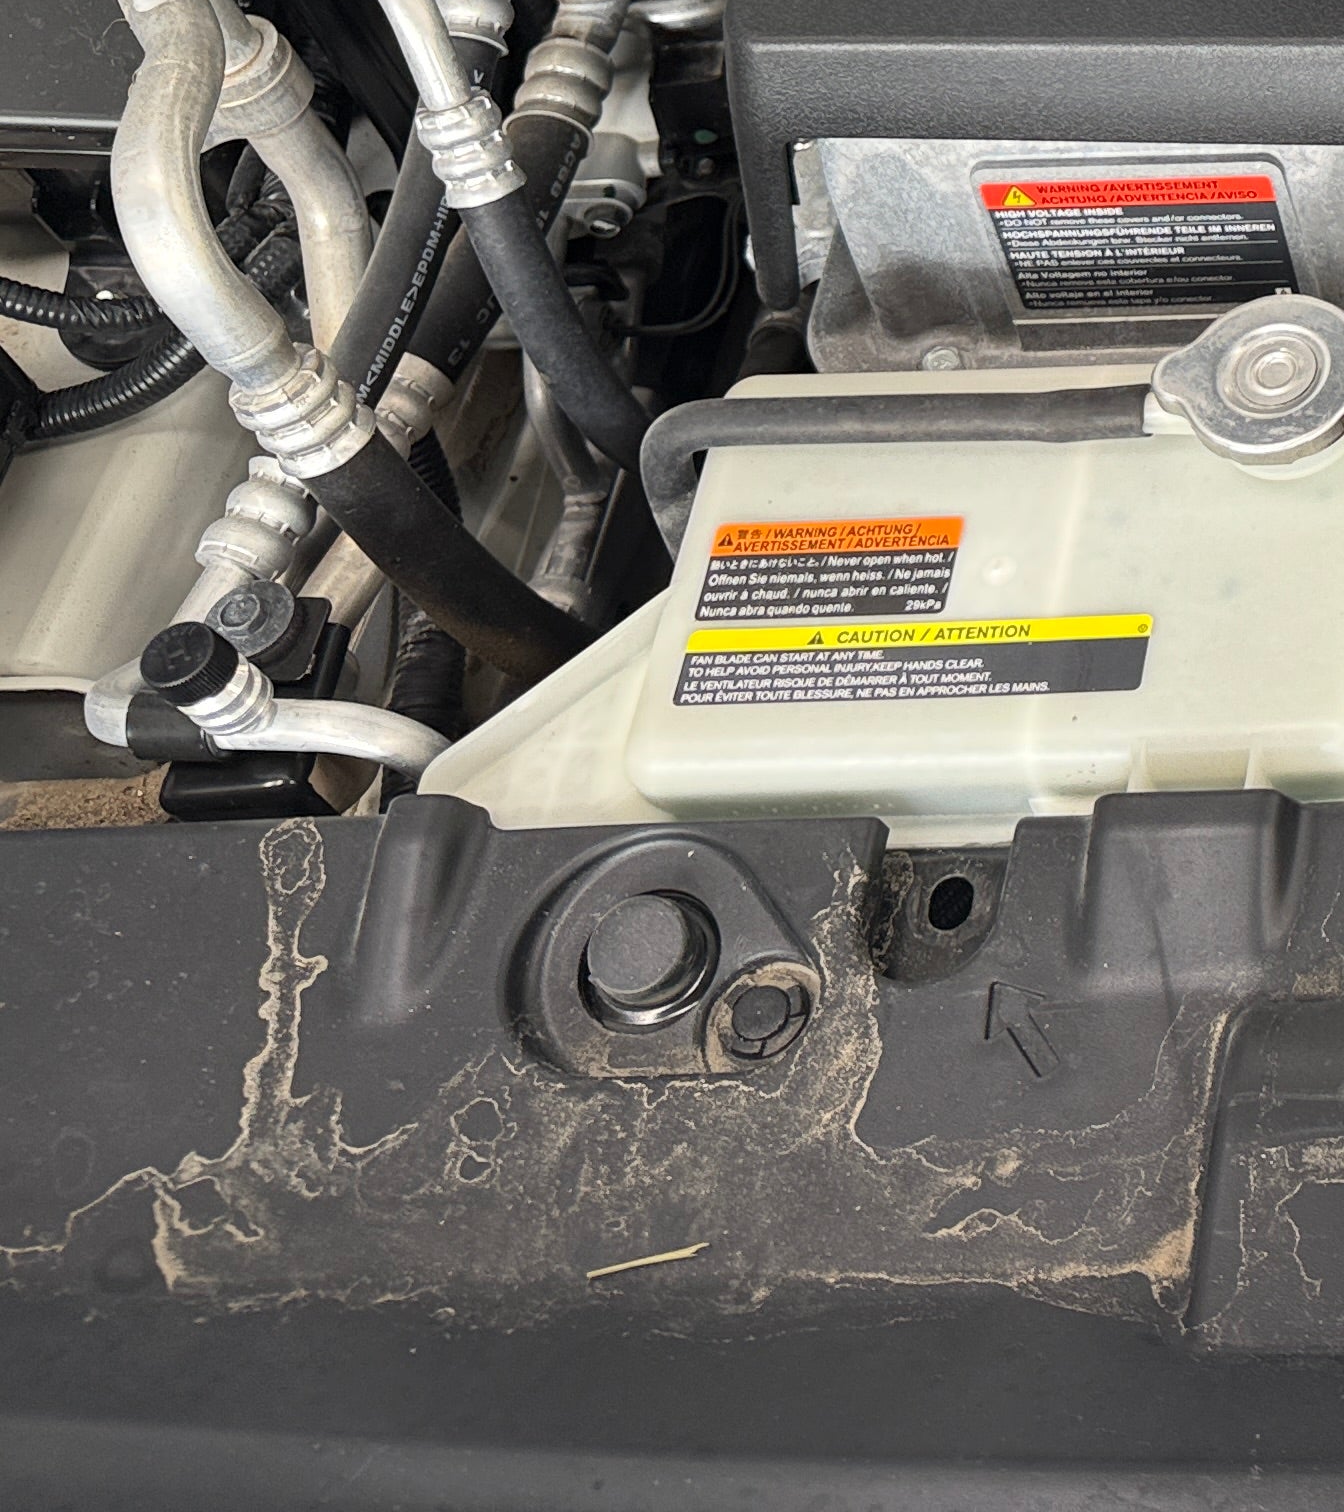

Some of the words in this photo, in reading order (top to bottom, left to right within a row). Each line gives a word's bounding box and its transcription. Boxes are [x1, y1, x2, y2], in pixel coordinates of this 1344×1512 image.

[1036, 184, 1098, 193] WARNING
[1040, 195, 1106, 204] ACHTUNG
[995, 210, 1025, 218] HIGH
[1027, 209, 1082, 217] VOLTAGE
[1083, 208, 1124, 216] INSIDE
[773, 526, 837, 539] WARNING
[846, 524, 912, 537] ACHTUNG
[733, 538, 848, 552] AVERTISSEMENT
[827, 555, 862, 567] Never
[862, 554, 890, 565] open
[892, 552, 923, 564] when
[923, 552, 945, 563] hot.
[749, 573, 767, 586] Sie
[819, 571, 850, 584] wenn
[852, 569, 885, 583] heiss.
[894, 569, 910, 581] Ne
[911, 568, 950, 581] jamais
[703, 589, 738, 602] ouvrir
[751, 587, 790, 601] chaud.
[802, 586, 837, 599] nunca
[840, 585, 868, 598] abrir
[870, 584, 886, 597] en
[888, 582, 938, 596] caliente.
[699, 605, 736, 617] Nunca
[738, 604, 764, 616] abra
[766, 603, 810, 615] quando
[811, 602, 854, 614] quente.
[903, 599, 941, 611] 29kPa
[837, 629, 915, 644] CAUTION
[934, 625, 1030, 640] ATTENTION
[690, 656, 712, 665] FAN
[714, 654, 750, 664] BLADE
[752, 653, 778, 663] CAN
[780, 652, 815, 662] START
[814, 652, 830, 661] AT
[830, 651, 856, 661] ANY
[856, 650, 884, 660] TIME.
[688, 668, 704, 677] TO
[705, 667, 735, 677] HELP
[736, 666, 770, 676] AVOID
[772, 664, 831, 675] PERSONAL
[903, 660, 945, 670] HANDS
[946, 659, 984, 669] CLEAR.
[683, 681, 697, 691] LE
[699, 679, 771, 691] VENTILATEUR
[772, 677, 814, 688] RISQUE
[816, 676, 834, 687] DE
[899, 674, 908, 684] À
[909, 673, 938, 684] TOUT
[939, 671, 991, 683] MOMENT.
[680, 693, 713, 703] POUR
[714, 692, 754, 702] ÉVITER
[755, 690, 791, 701] TOUTE
[791, 688, 854, 700] BLESSURE,
[855, 688, 873, 698] NE
[874, 687, 897, 697] PAS
[899, 686, 915, 696] EN
[916, 684, 988, 696] APPROCHER
[988, 683, 1009, 693] LES
[1011, 682, 1051, 692] MAINS.
